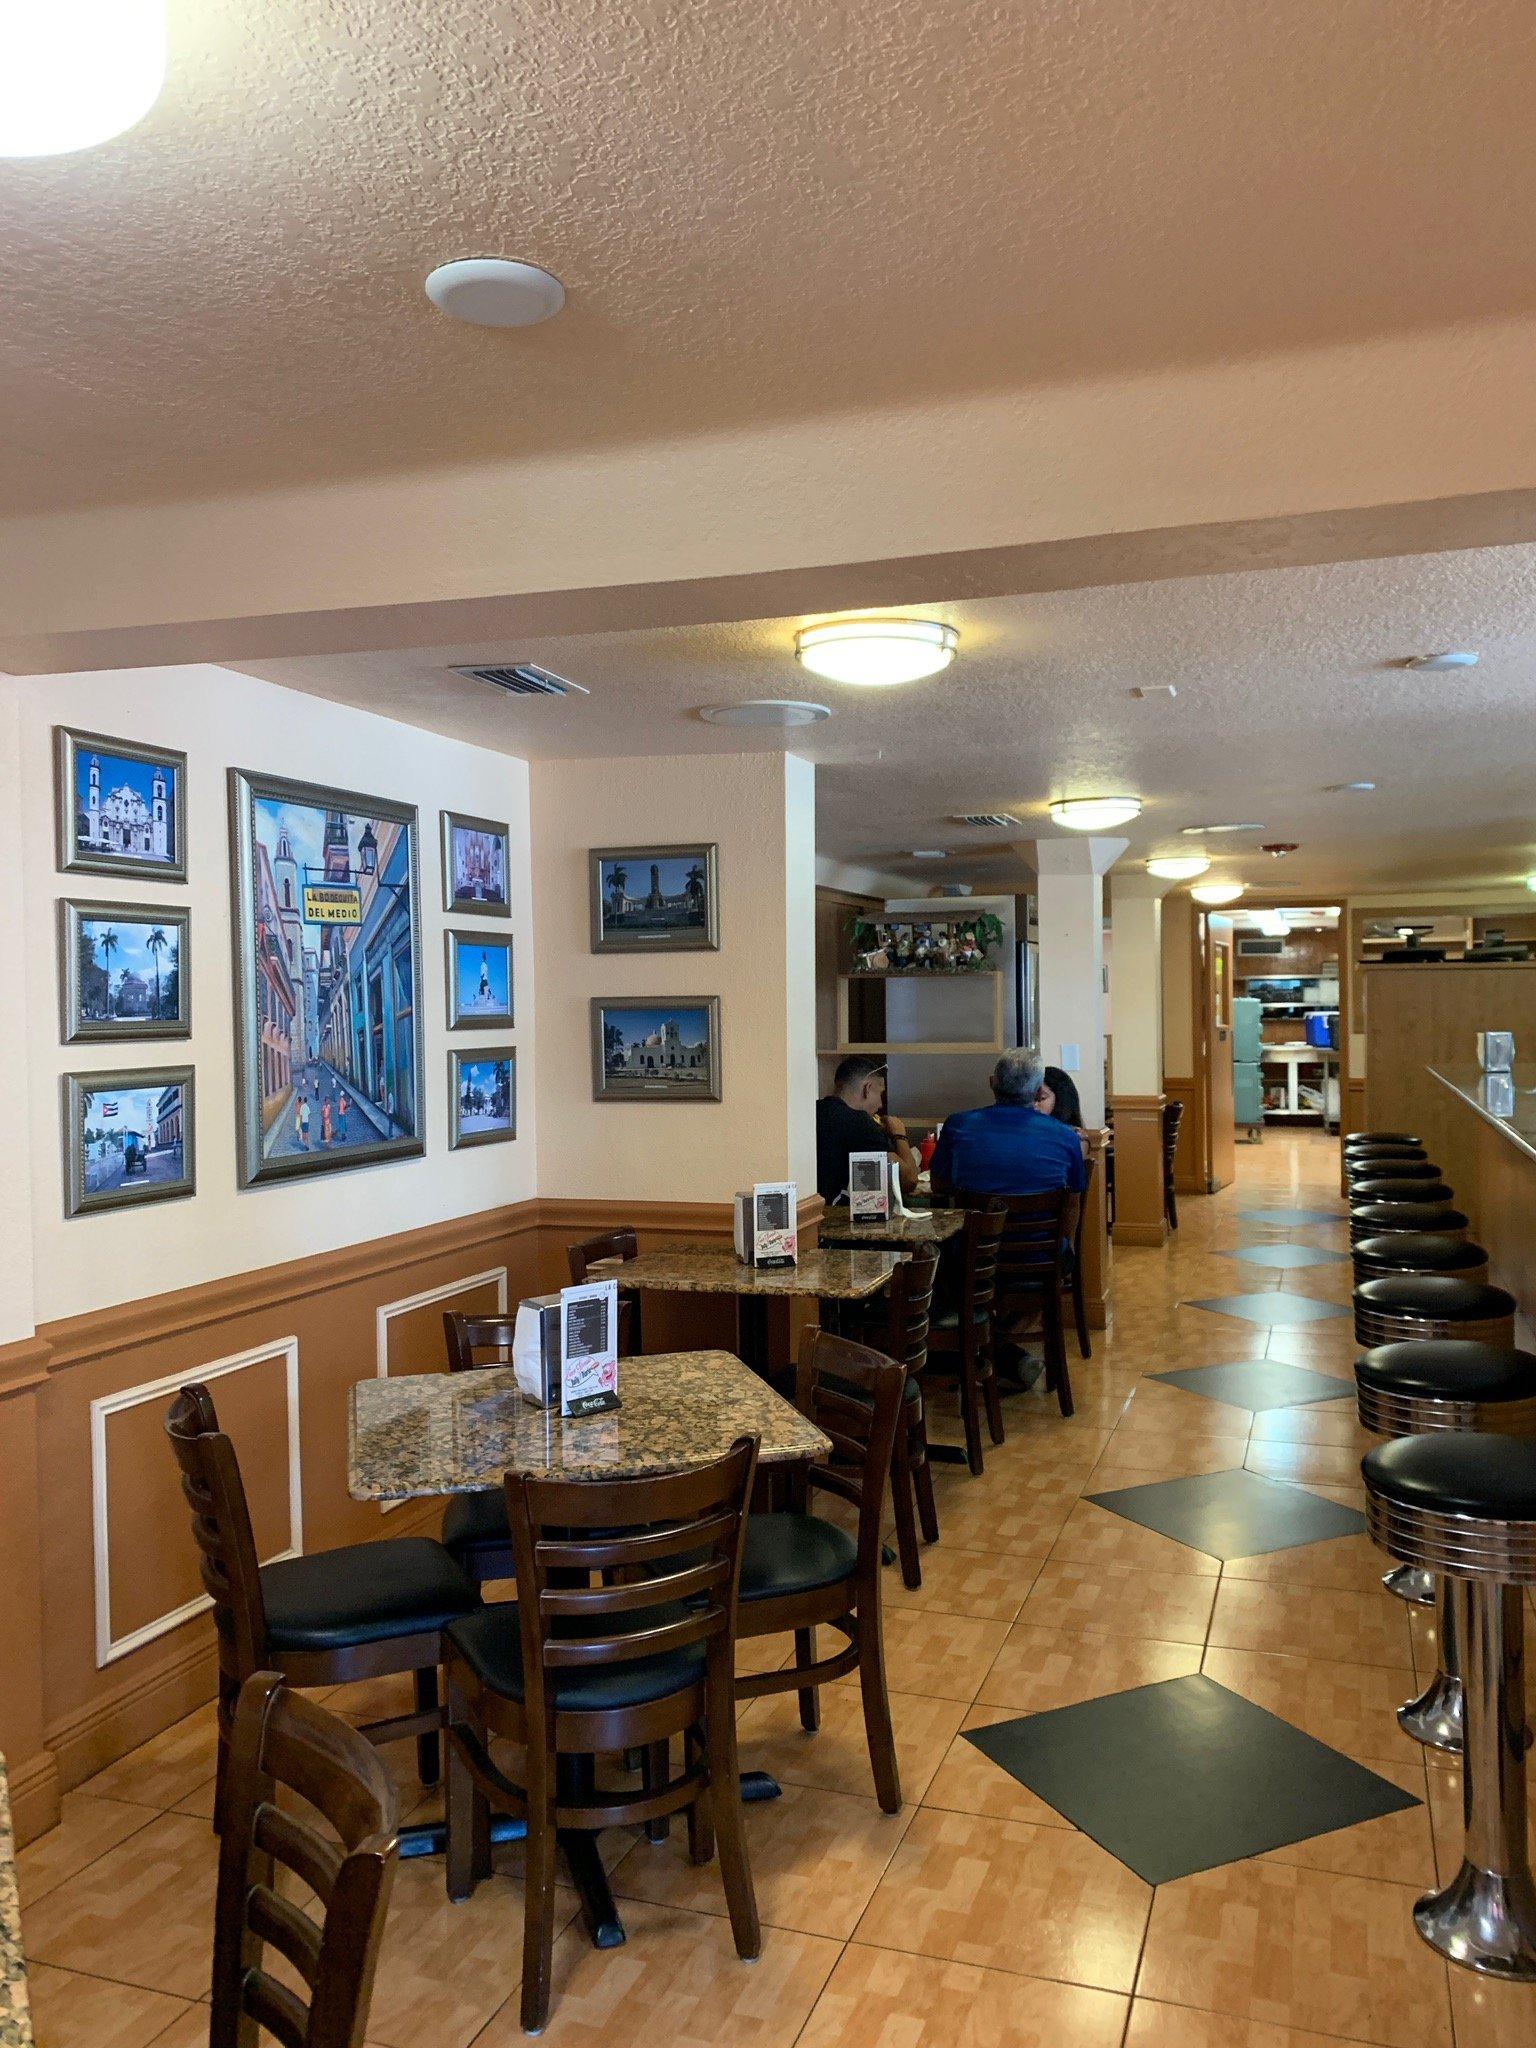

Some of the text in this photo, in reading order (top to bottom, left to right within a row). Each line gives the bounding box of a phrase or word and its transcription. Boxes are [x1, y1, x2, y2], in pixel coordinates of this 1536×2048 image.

[306, 892, 318, 902] LA
[308, 908, 357, 918] DEL MEDIO
